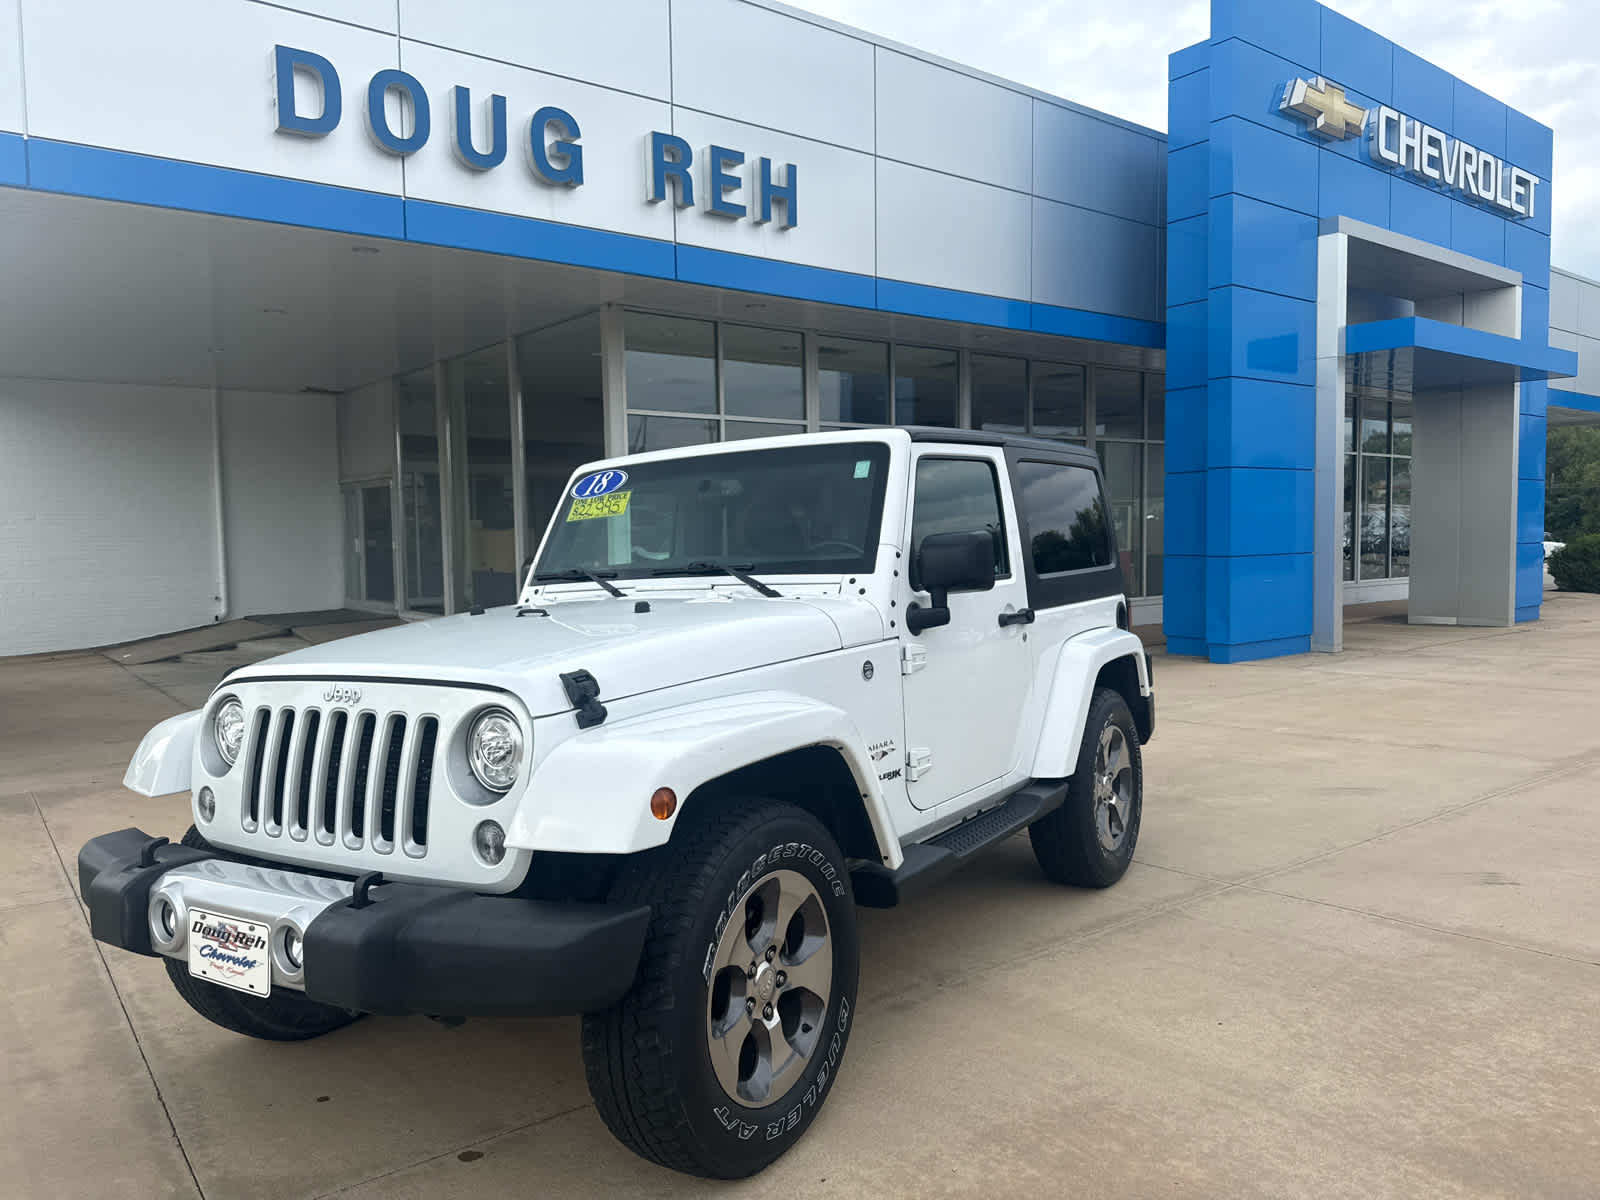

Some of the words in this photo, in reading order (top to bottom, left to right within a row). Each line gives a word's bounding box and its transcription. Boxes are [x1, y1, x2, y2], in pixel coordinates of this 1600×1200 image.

[273, 43, 585, 190] DOUG
[646, 131, 799, 231] REH
[1371, 104, 1540, 218] CHEVROLET
[582, 471, 613, 496] 18
[323, 682, 361, 707] Jeep
[192, 921, 231, 943] Doug
[233, 930, 267, 950] Reh
[199, 944, 257, 968] Chevrolet
[765, 996, 850, 1142] DUELER
[713, 1103, 760, 1140] A/T
